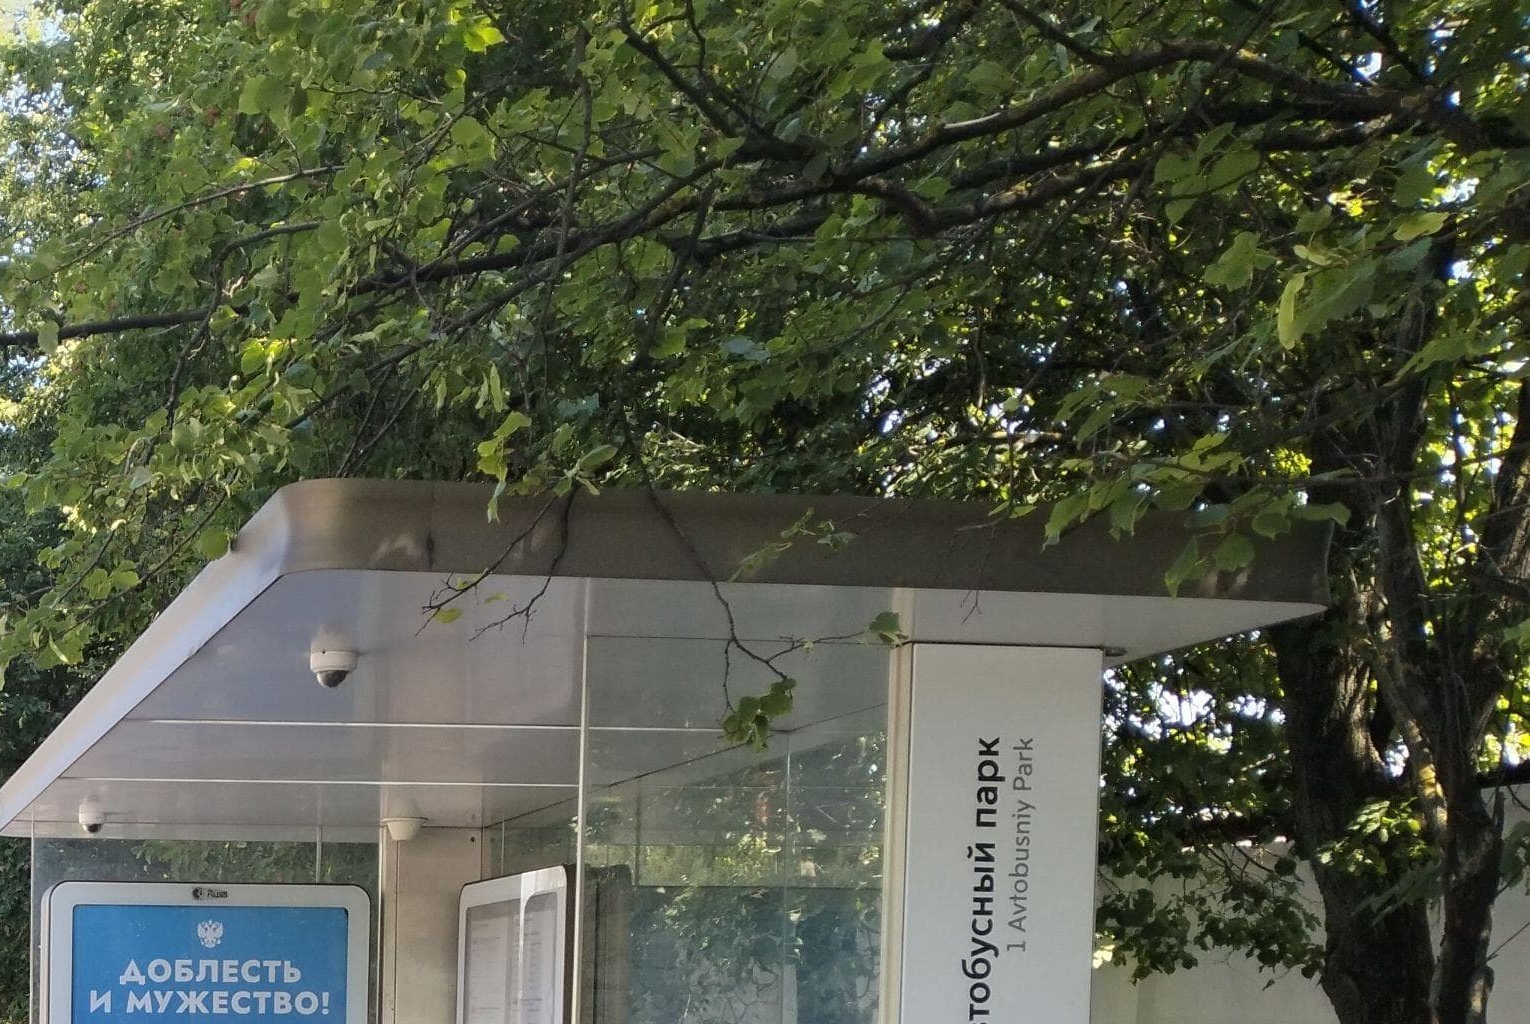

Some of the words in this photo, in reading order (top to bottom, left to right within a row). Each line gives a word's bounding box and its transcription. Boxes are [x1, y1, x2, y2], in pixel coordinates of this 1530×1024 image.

[975, 736, 1007, 828] парк
[1012, 737, 1034, 791] Park
[1007, 799, 1036, 933] Avtobusniy
[1006, 940, 1026, 952] 1
[119, 958, 302, 986] ДОБЛЕСТЬ
[89, 989, 112, 1014] И
[126, 990, 330, 1016] МУЖЕСТВО!
